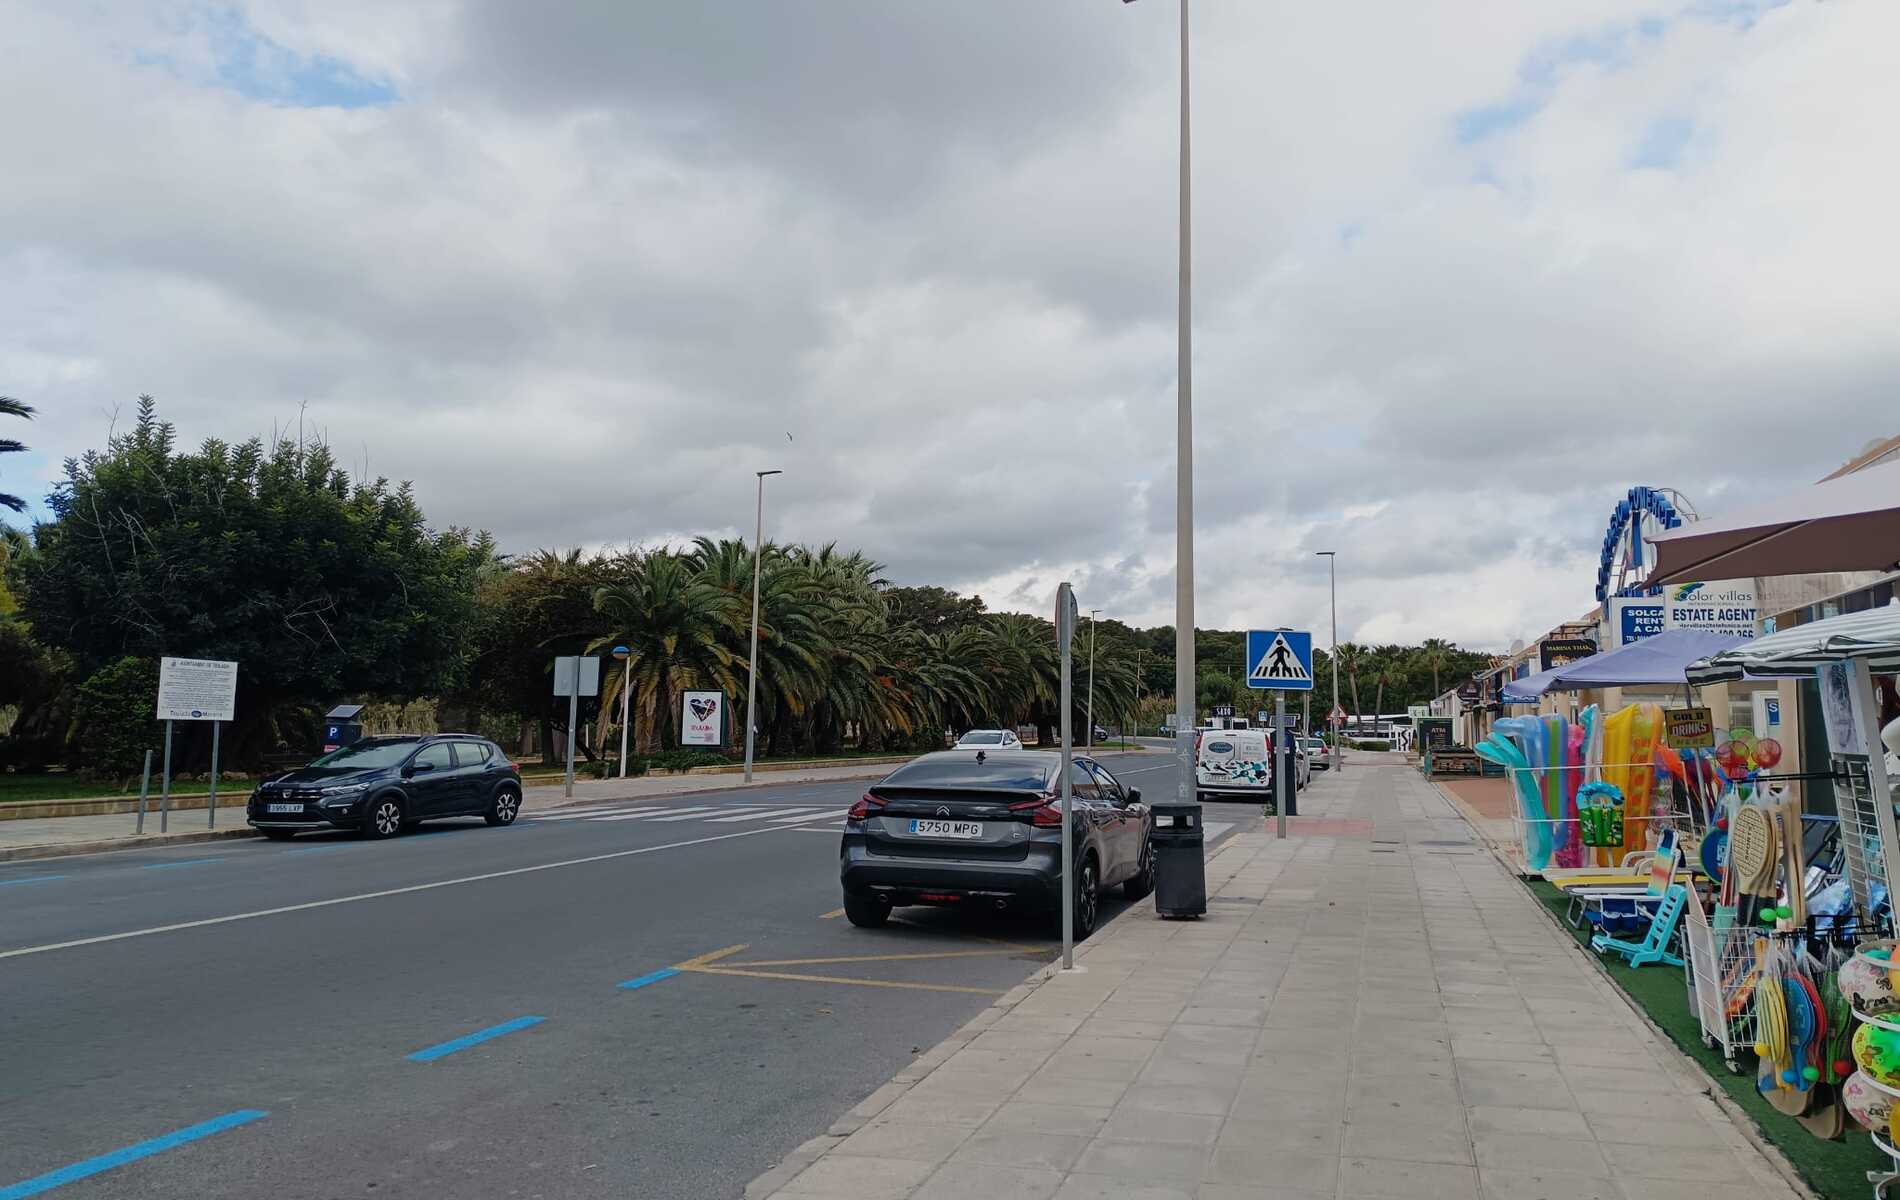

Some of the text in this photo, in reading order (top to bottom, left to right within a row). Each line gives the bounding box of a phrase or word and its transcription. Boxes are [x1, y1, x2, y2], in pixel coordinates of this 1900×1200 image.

[1719, 590, 1753, 601] villas
[1672, 608, 1757, 621] ESTATE AGENT
[329, 727, 338, 737] P
[1672, 721, 1707, 737] DRINKS
[918, 821, 979, 835] 5750 MPG
